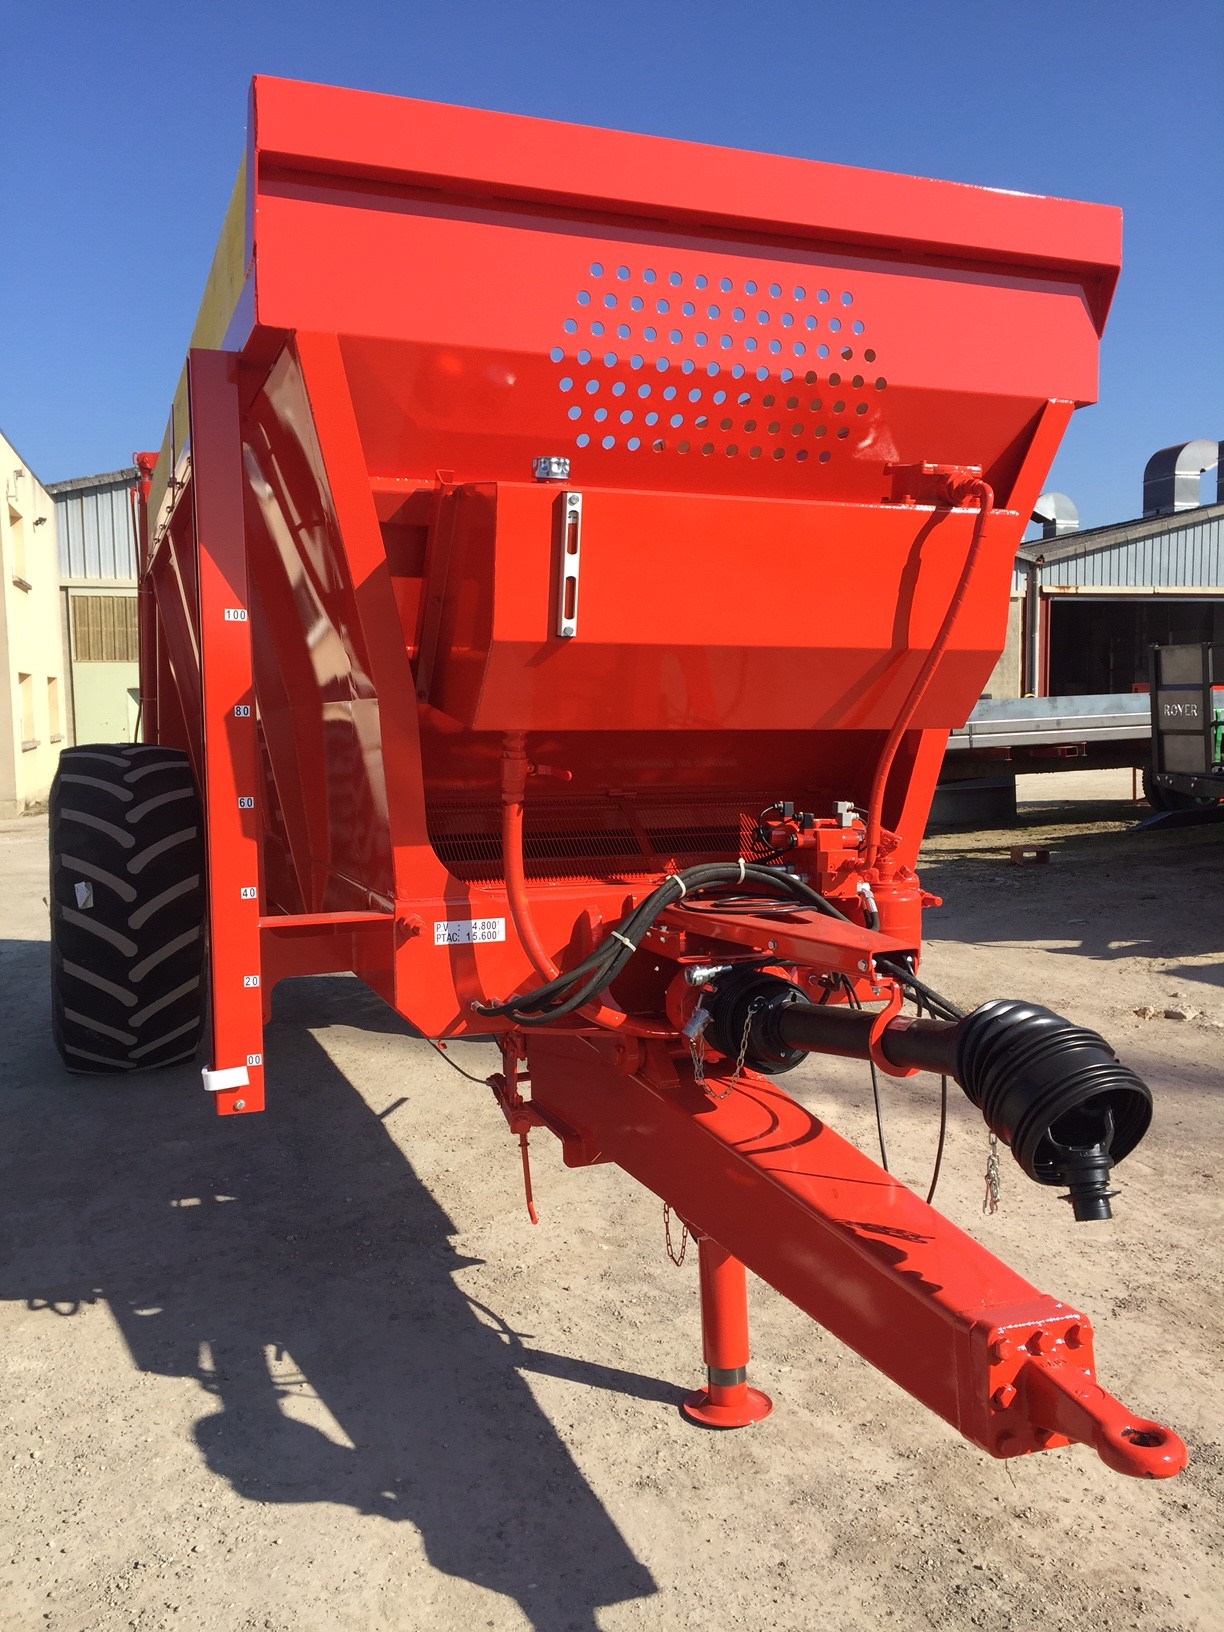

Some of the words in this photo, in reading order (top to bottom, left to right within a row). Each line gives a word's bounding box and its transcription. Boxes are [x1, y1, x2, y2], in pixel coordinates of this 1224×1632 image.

[226, 610, 246, 620] 100
[235, 706, 249, 716] 80
[239, 798, 253, 808] 60
[242, 888, 256, 898] 40
[436, 932, 460, 943] PTAC:
[245, 976, 258, 986] 20
[248, 1055, 261, 1065] 00
